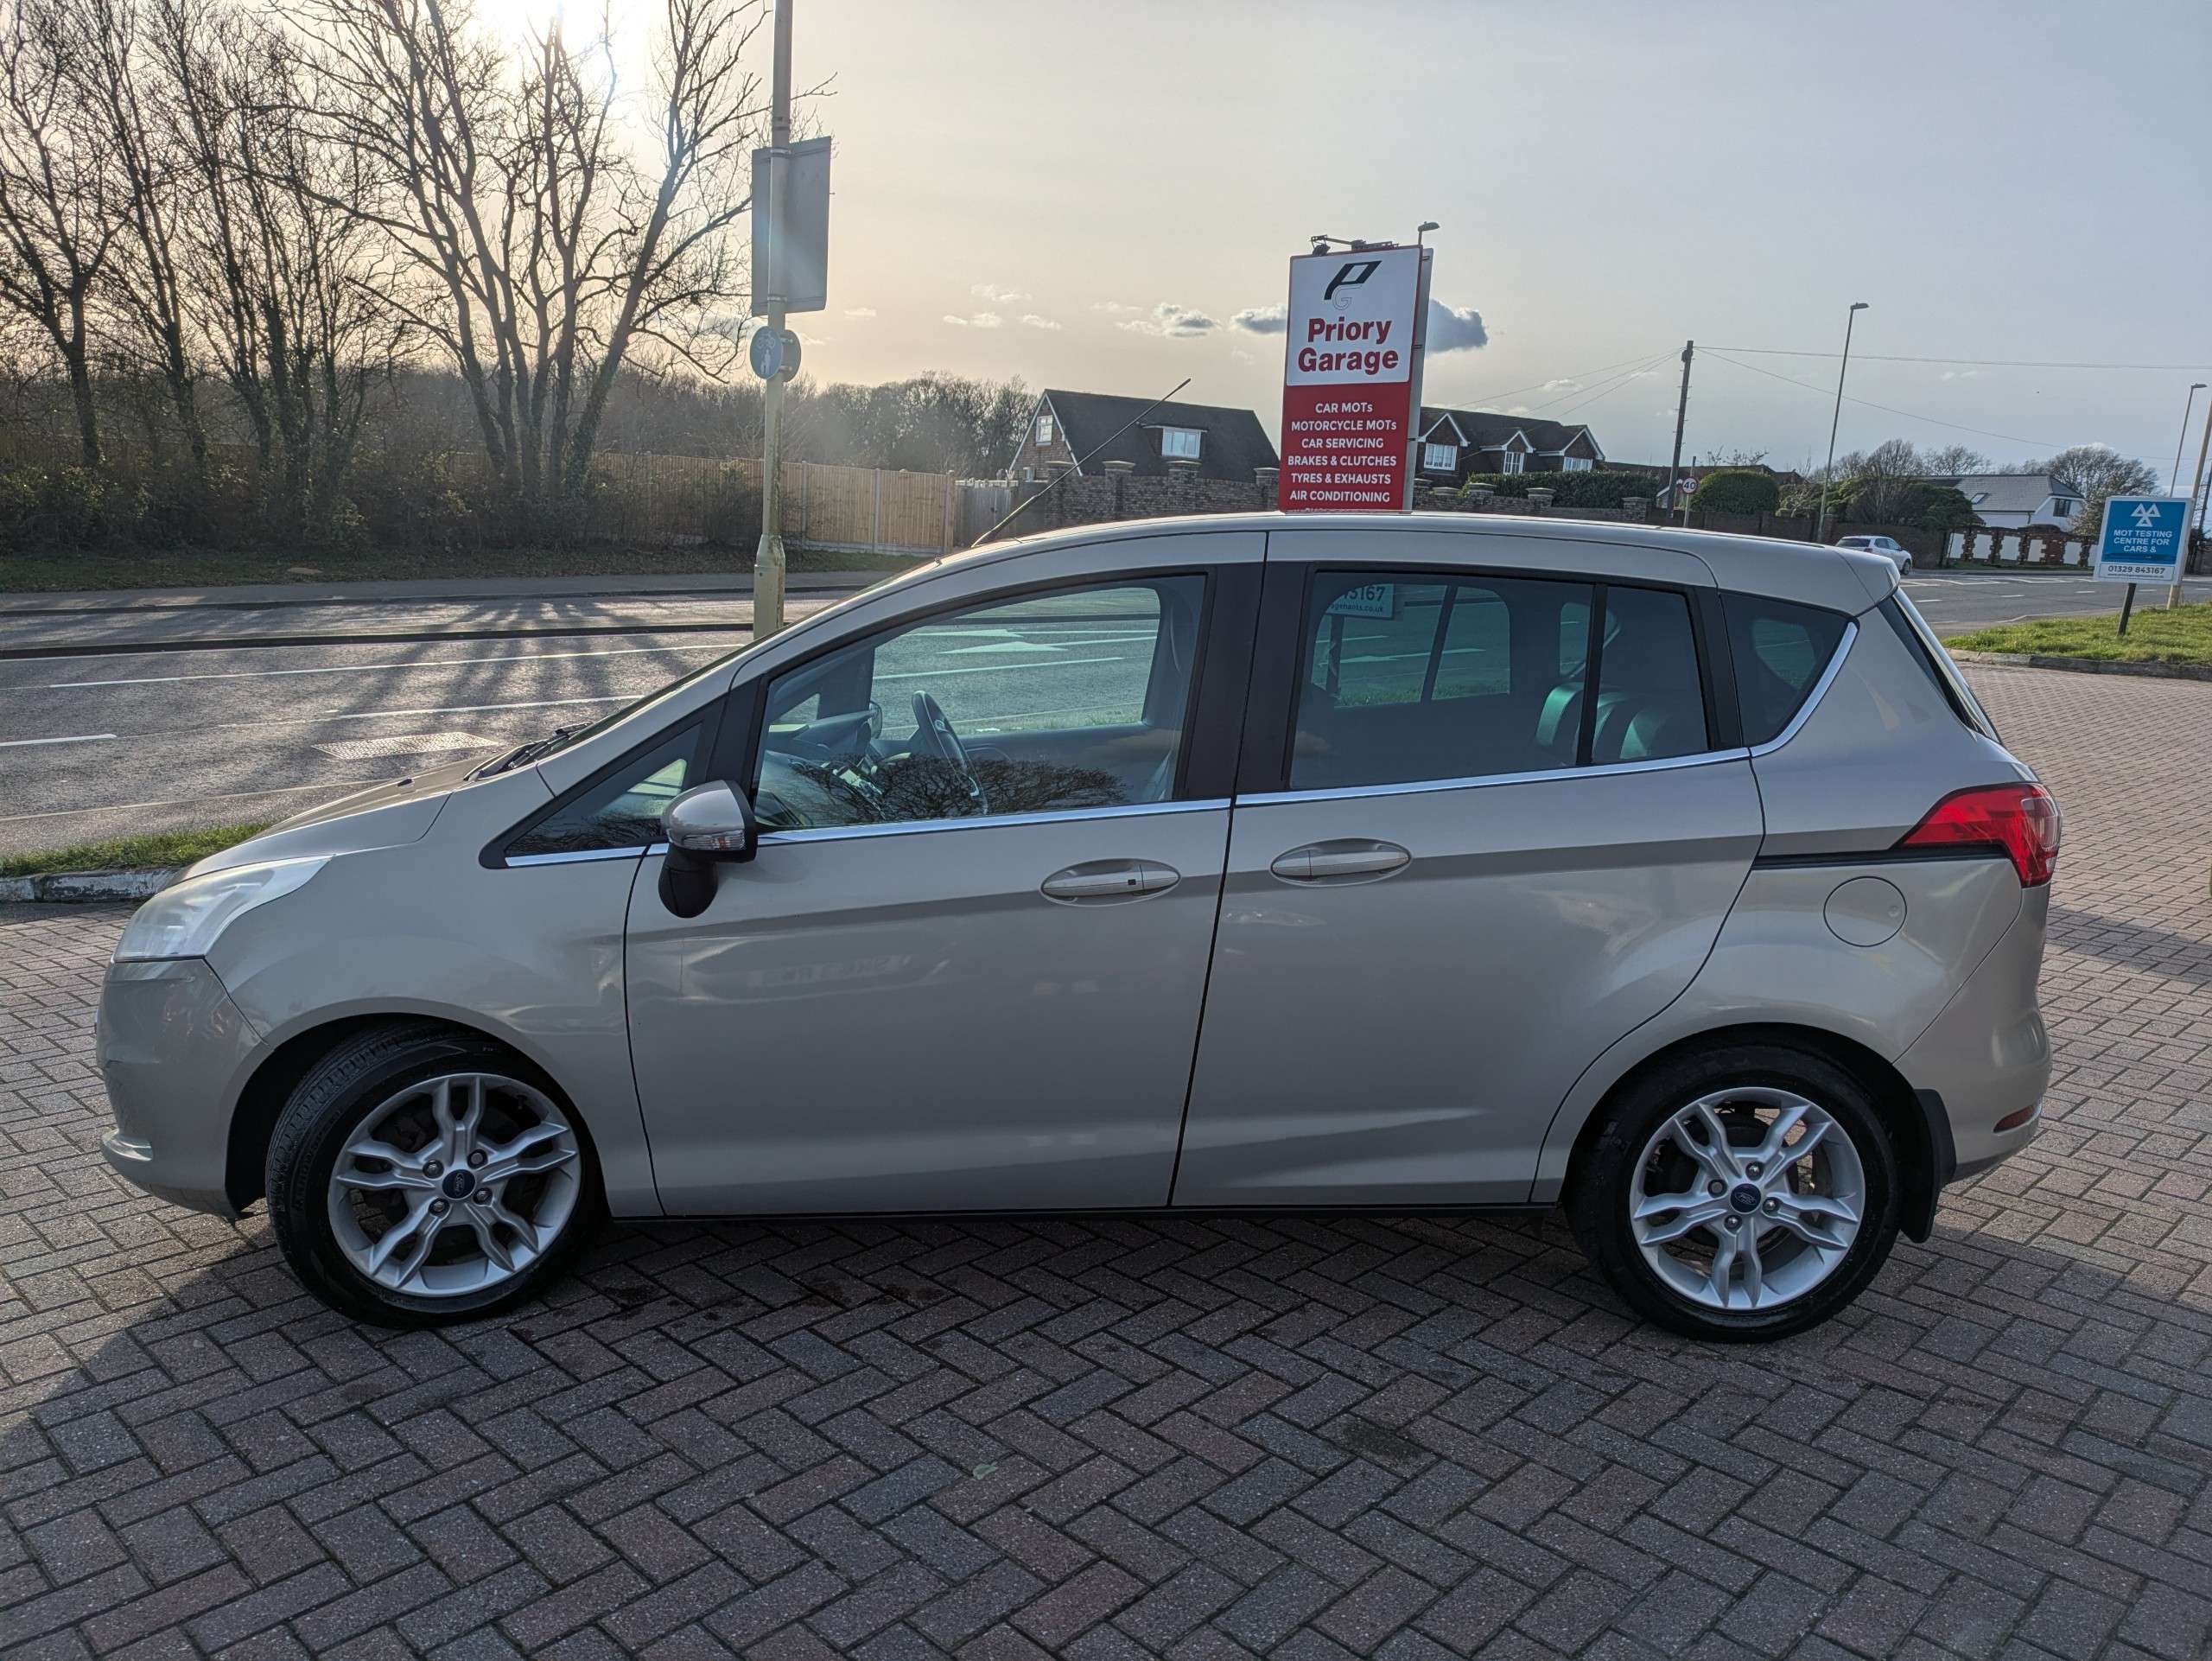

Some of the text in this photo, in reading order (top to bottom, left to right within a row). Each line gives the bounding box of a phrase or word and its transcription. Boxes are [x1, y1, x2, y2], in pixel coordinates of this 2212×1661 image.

[1307, 316, 1392, 345] Priory
[1298, 347, 1399, 375] Garage
[1315, 402, 1373, 413] CAR MOTs
[1291, 419, 1397, 431] MOTORCYCLE MOTs
[1301, 437, 1384, 449] CAR SERVICING
[1287, 455, 1397, 467] BRAKES & CLUTCHES
[1291, 473, 1391, 484] TYRES & EXHAUSTS
[1684, 481, 1695, 490] 40
[1289, 490, 1390, 503] AIR CONDITIONING
[2113, 537, 2170, 546] CENTRE FOR
